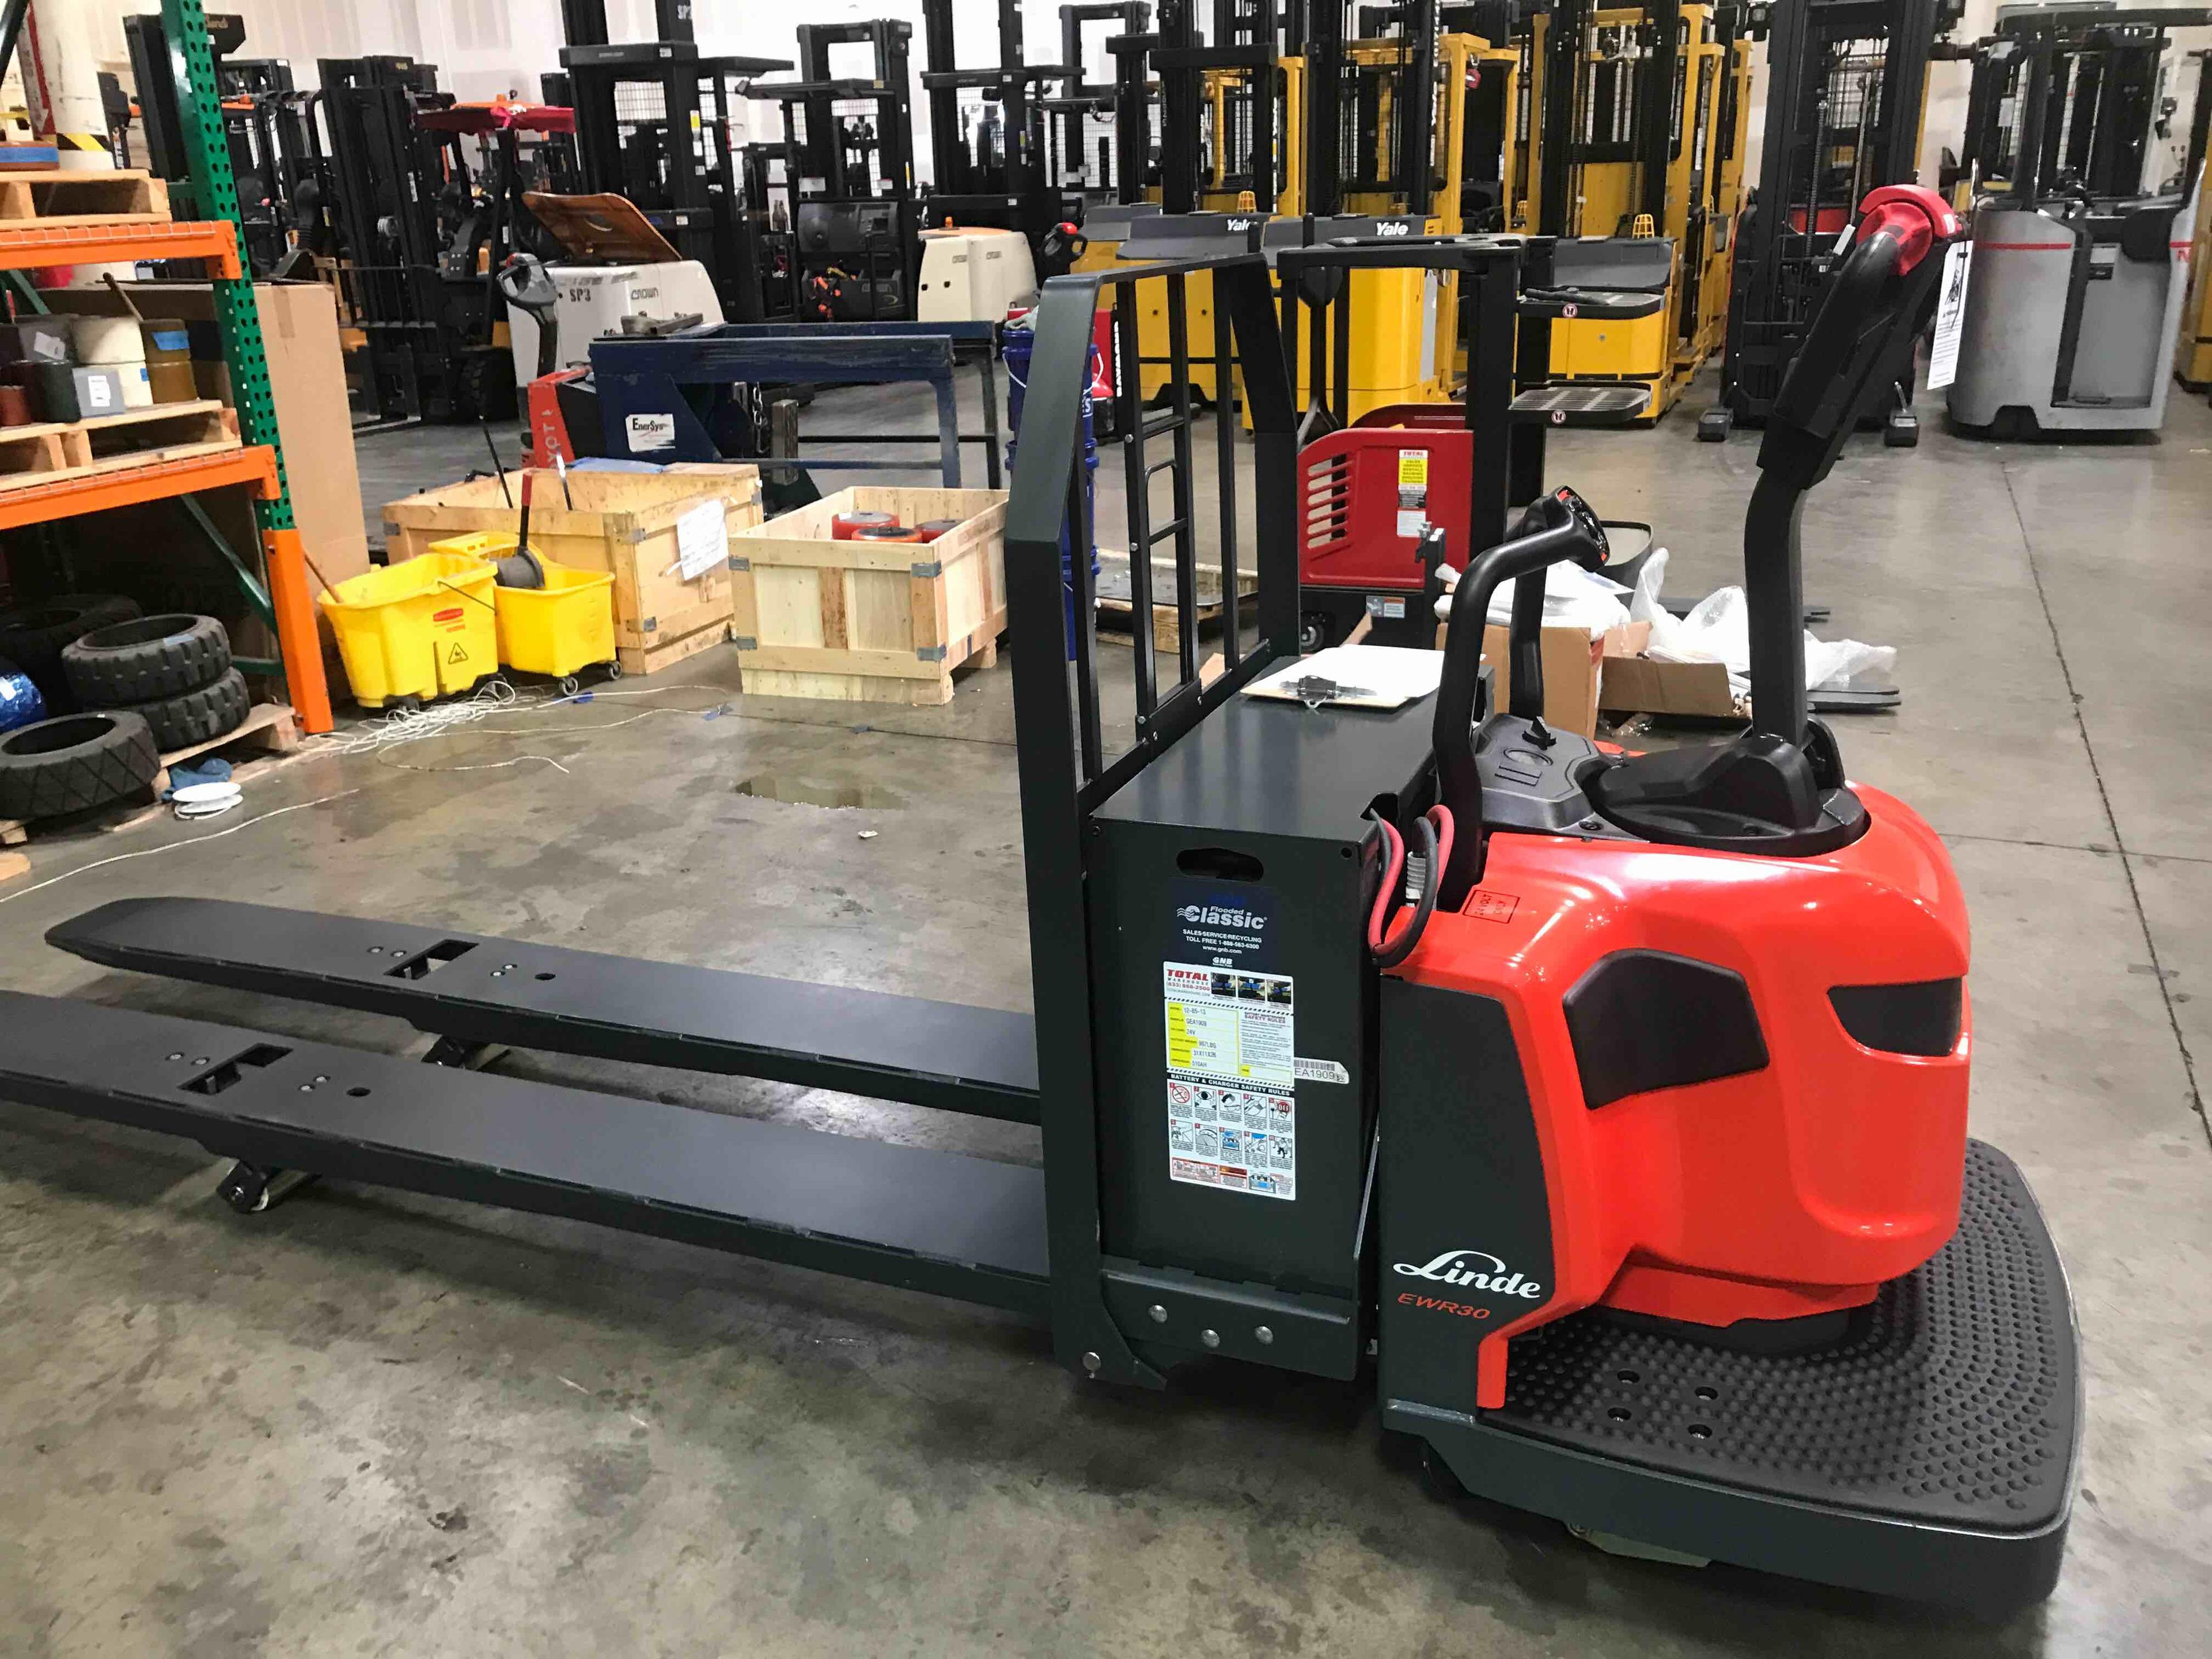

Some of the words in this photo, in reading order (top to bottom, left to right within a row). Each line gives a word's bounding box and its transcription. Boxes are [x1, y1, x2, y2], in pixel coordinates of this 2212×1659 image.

[1376, 222, 1408, 236] Yale
[569, 288, 591, 302] SP3
[1184, 905, 1265, 930] Classic
[1210, 906, 1244, 915] Flooded
[1202, 945, 1242, 954] www.gnb.com
[1167, 969, 1209, 981] TOTAL
[1171, 1074, 1199, 1083] BATTERY
[1208, 1080, 1239, 1089] CHARGER
[1241, 1084, 1267, 1093] SAFETY
[1393, 1250, 1541, 1298] Linde
[1397, 1293, 1491, 1319] EWR30
